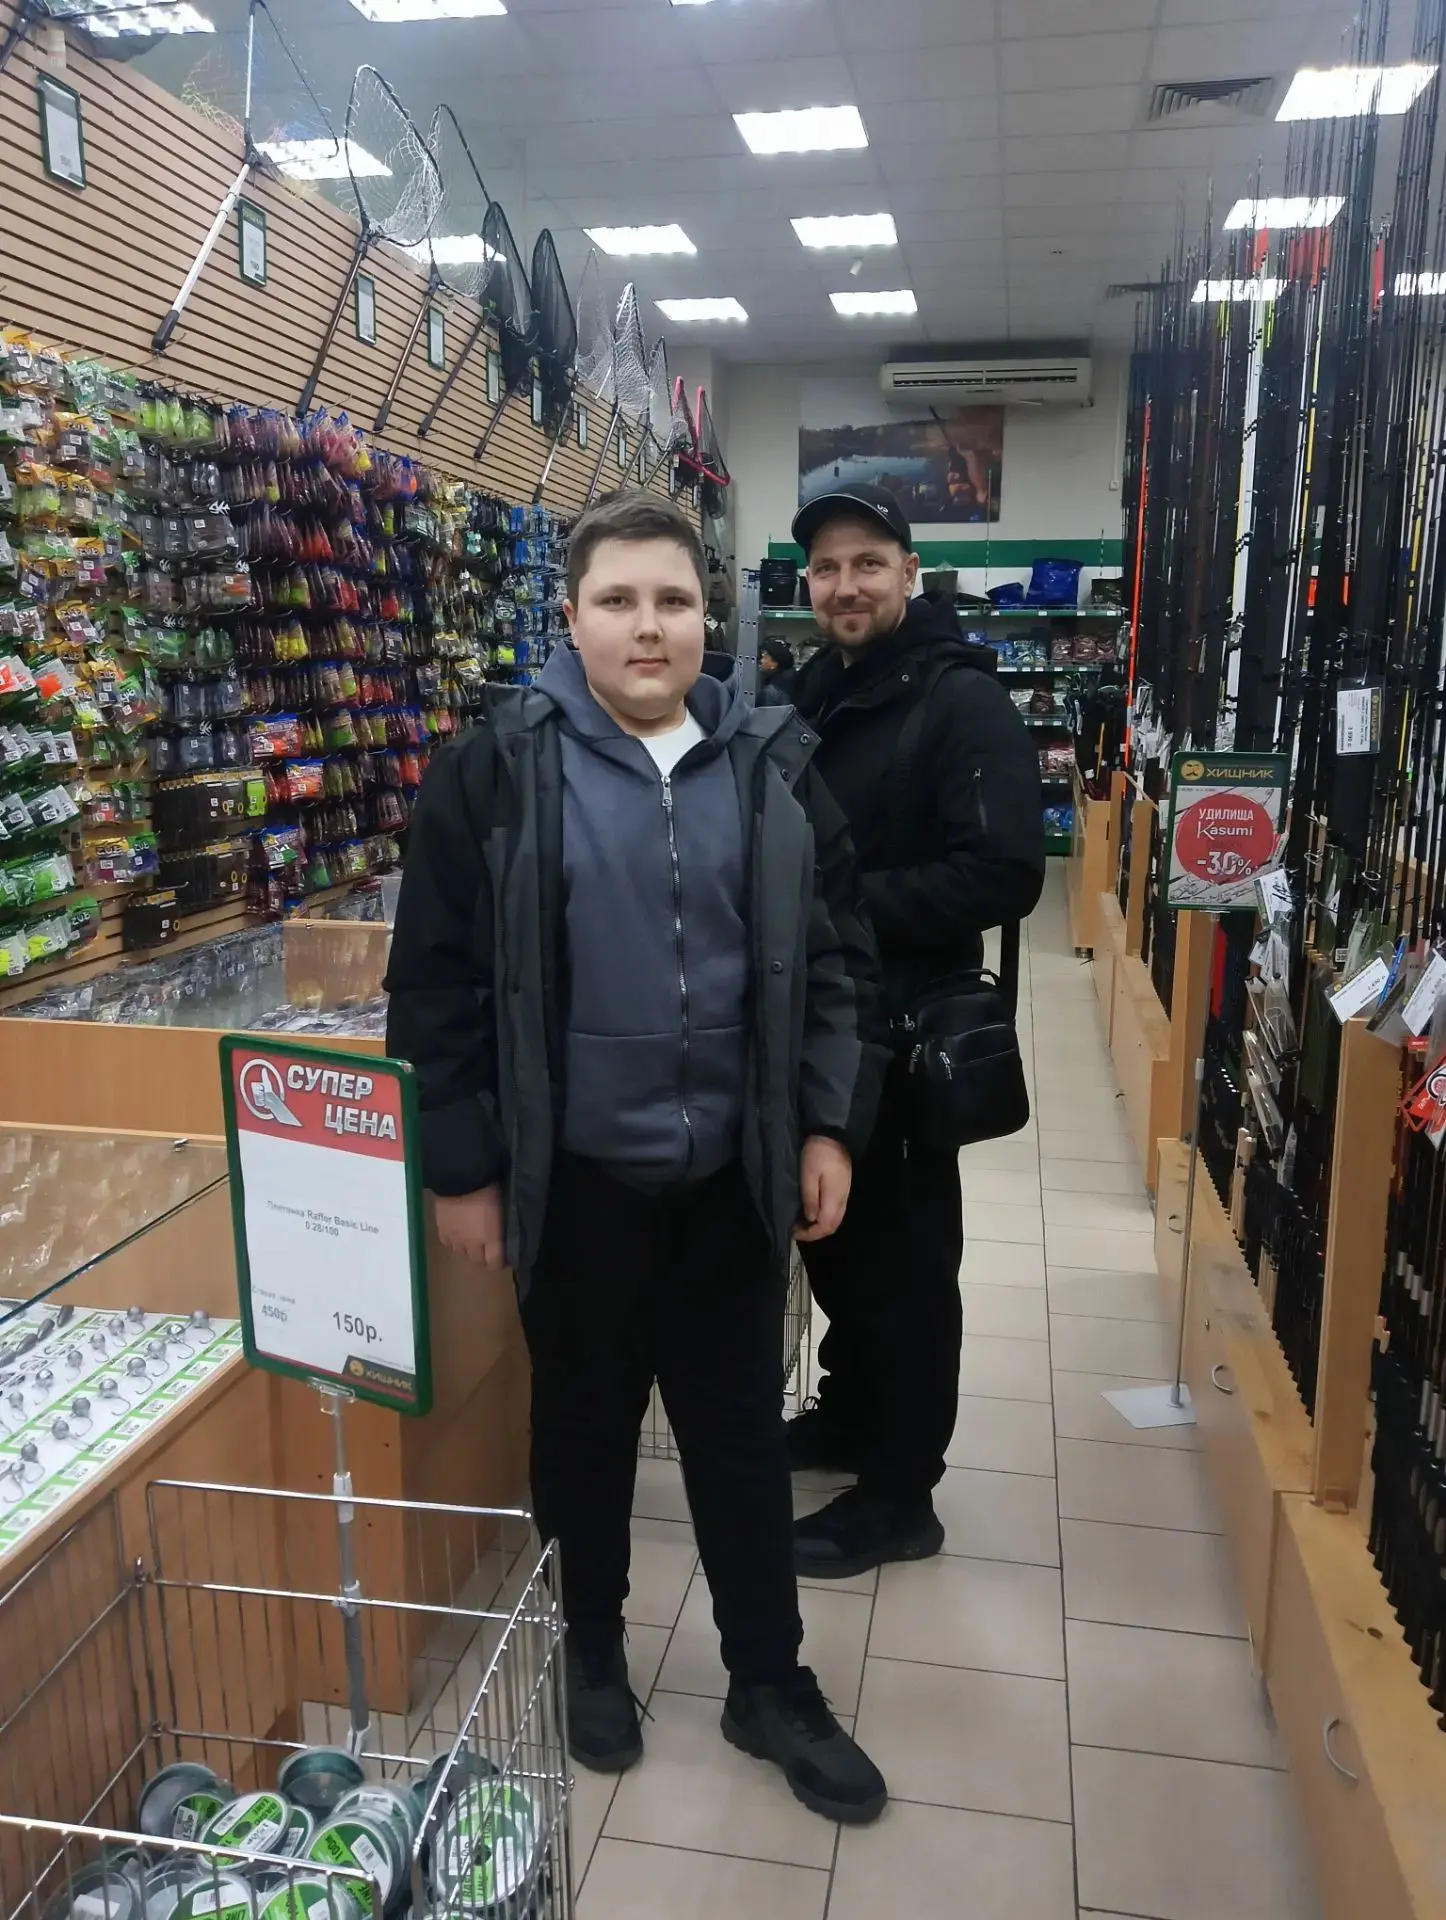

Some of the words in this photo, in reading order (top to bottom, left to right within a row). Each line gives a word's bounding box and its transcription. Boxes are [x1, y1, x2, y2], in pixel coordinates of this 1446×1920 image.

[1206, 767, 1274, 779] ХИЩНИК
[1197, 821, 1253, 840] Kasumi
[1197, 851, 1252, 876] -30%
[287, 1064, 373, 1101] СУПЕР
[323, 1103, 397, 1140] ЦЕНА
[307, 1209, 332, 1224] Raffer
[333, 1216, 358, 1230] Basic
[360, 1222, 379, 1234] Line
[333, 1311, 382, 1343] 150р.
